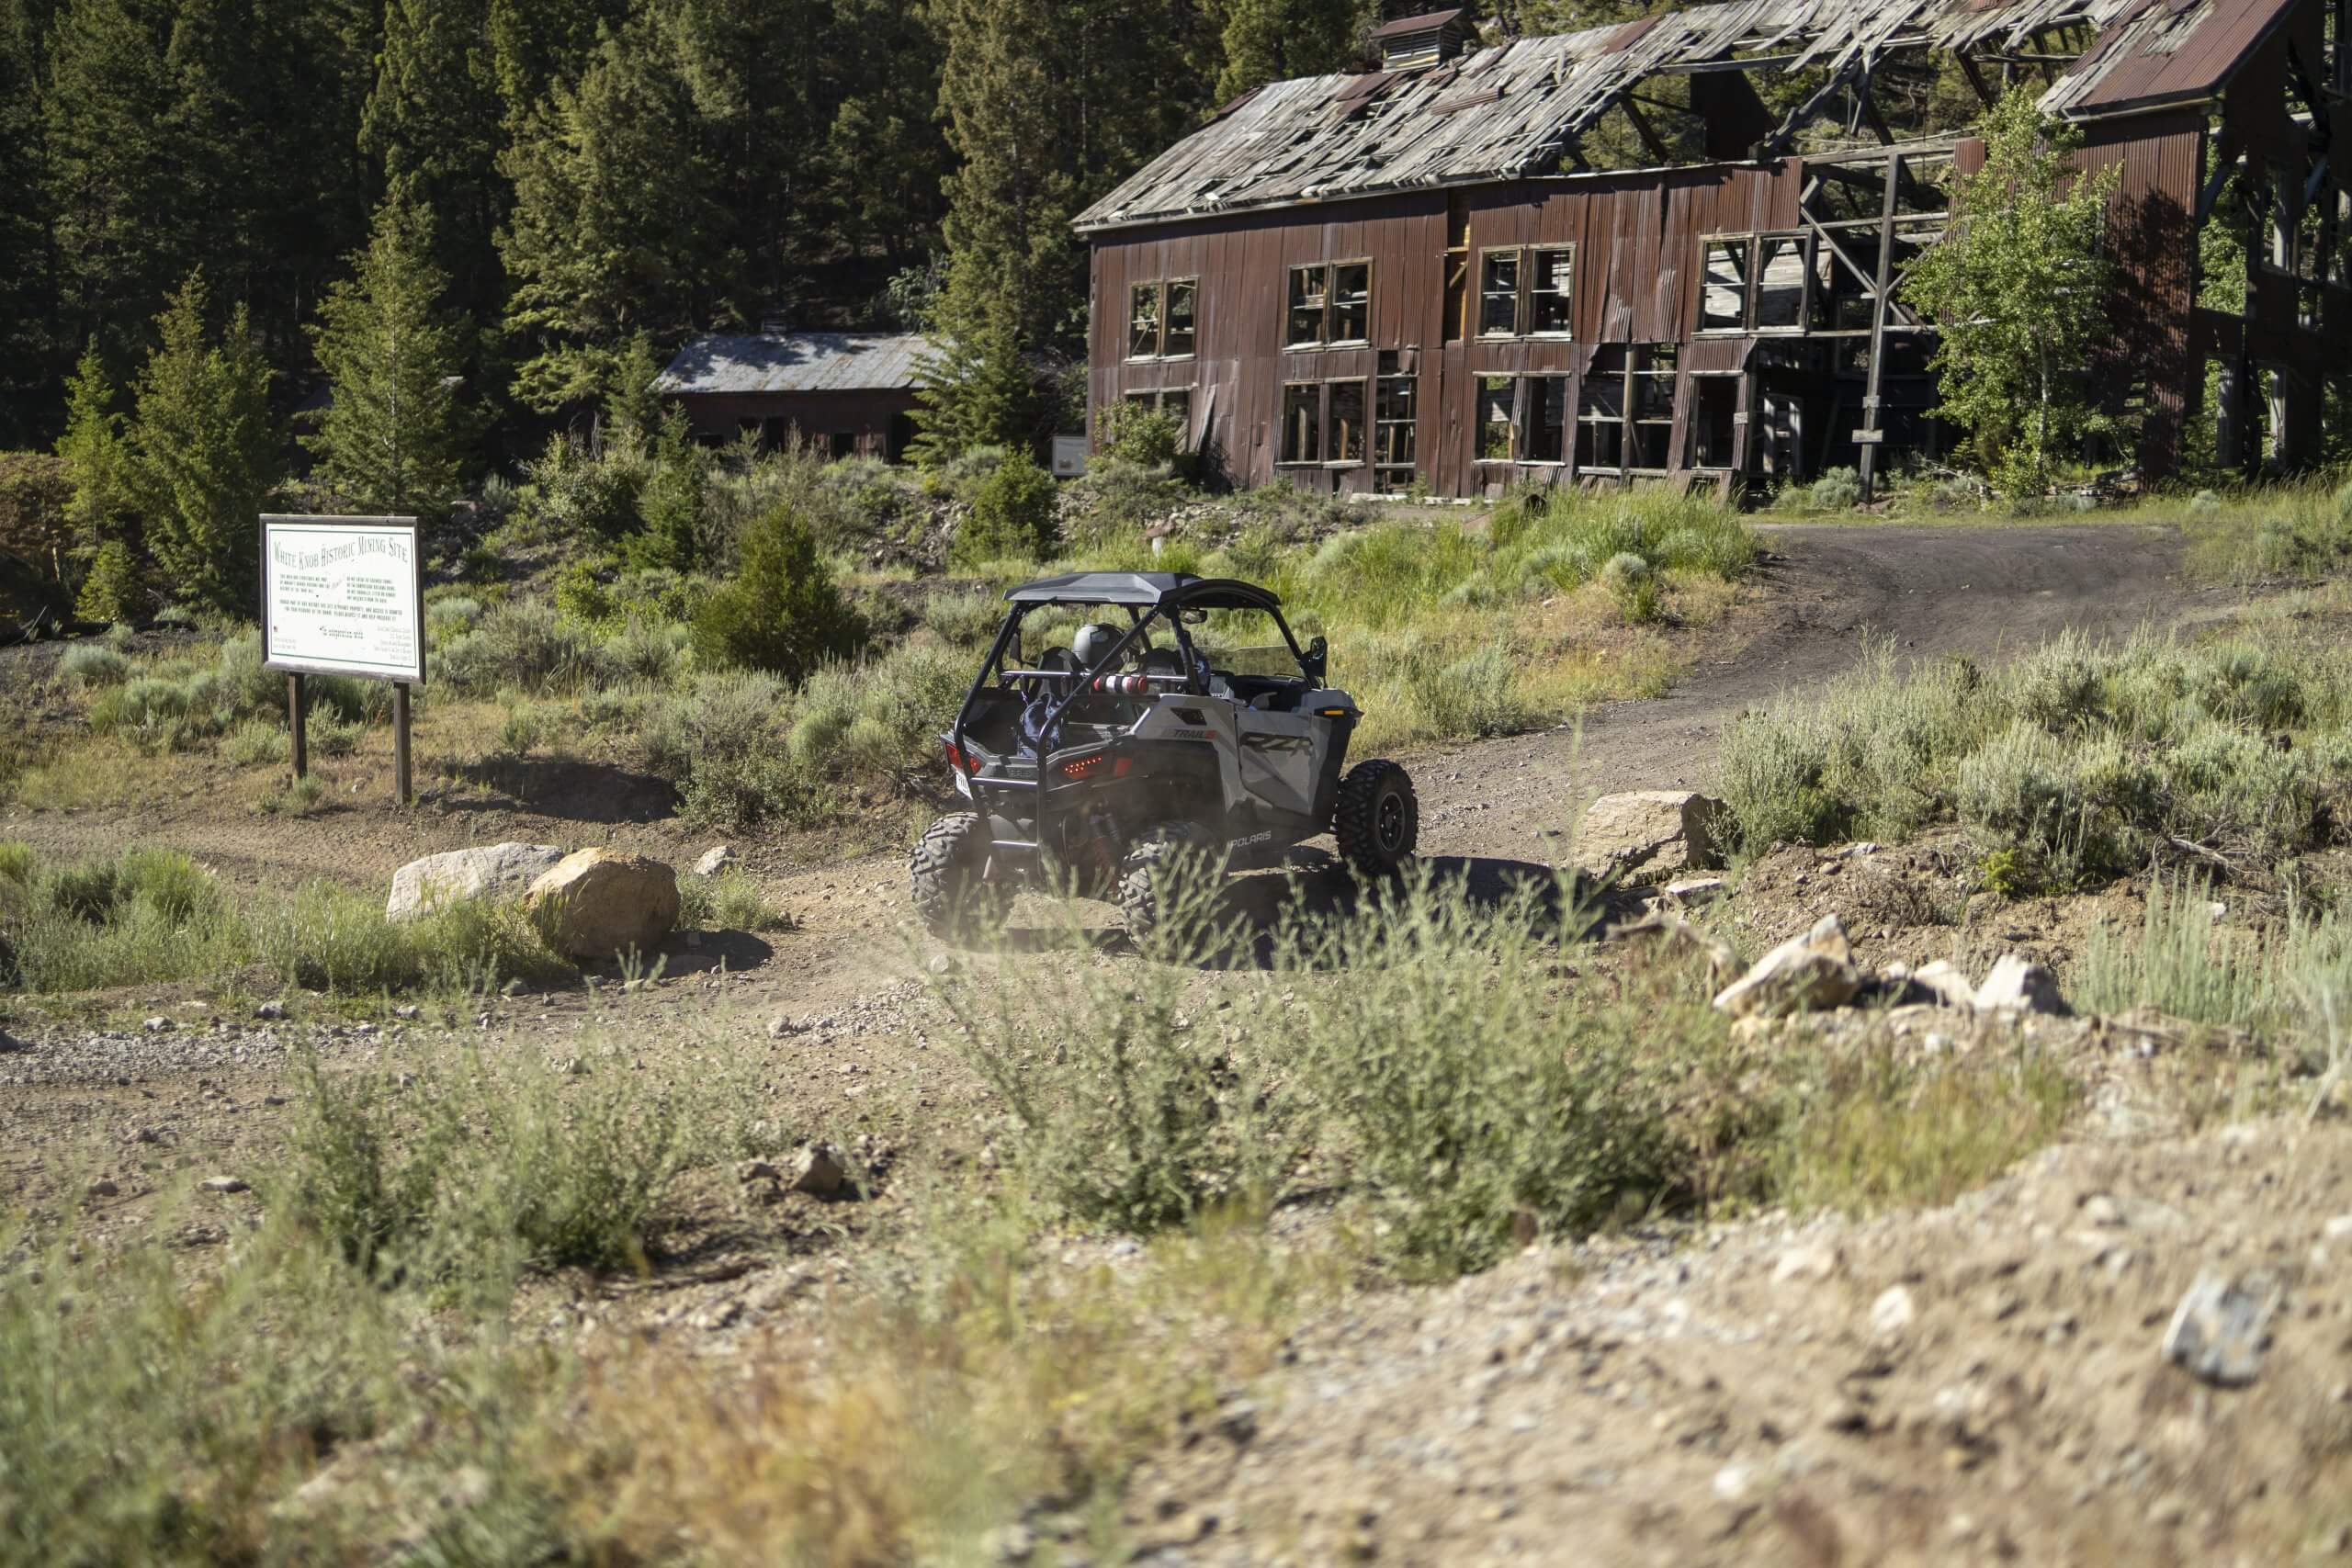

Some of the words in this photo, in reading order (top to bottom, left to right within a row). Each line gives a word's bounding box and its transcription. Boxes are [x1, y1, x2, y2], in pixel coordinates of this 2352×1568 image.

[274, 541, 297, 568] WHITE
[299, 550, 319, 570] KNOB
[322, 543, 356, 567] HISTORIC
[358, 536, 386, 556] MINING
[389, 536, 408, 563] SITE
[1240, 731, 1313, 756] RZR
[1230, 830, 1272, 847] POLARIS
